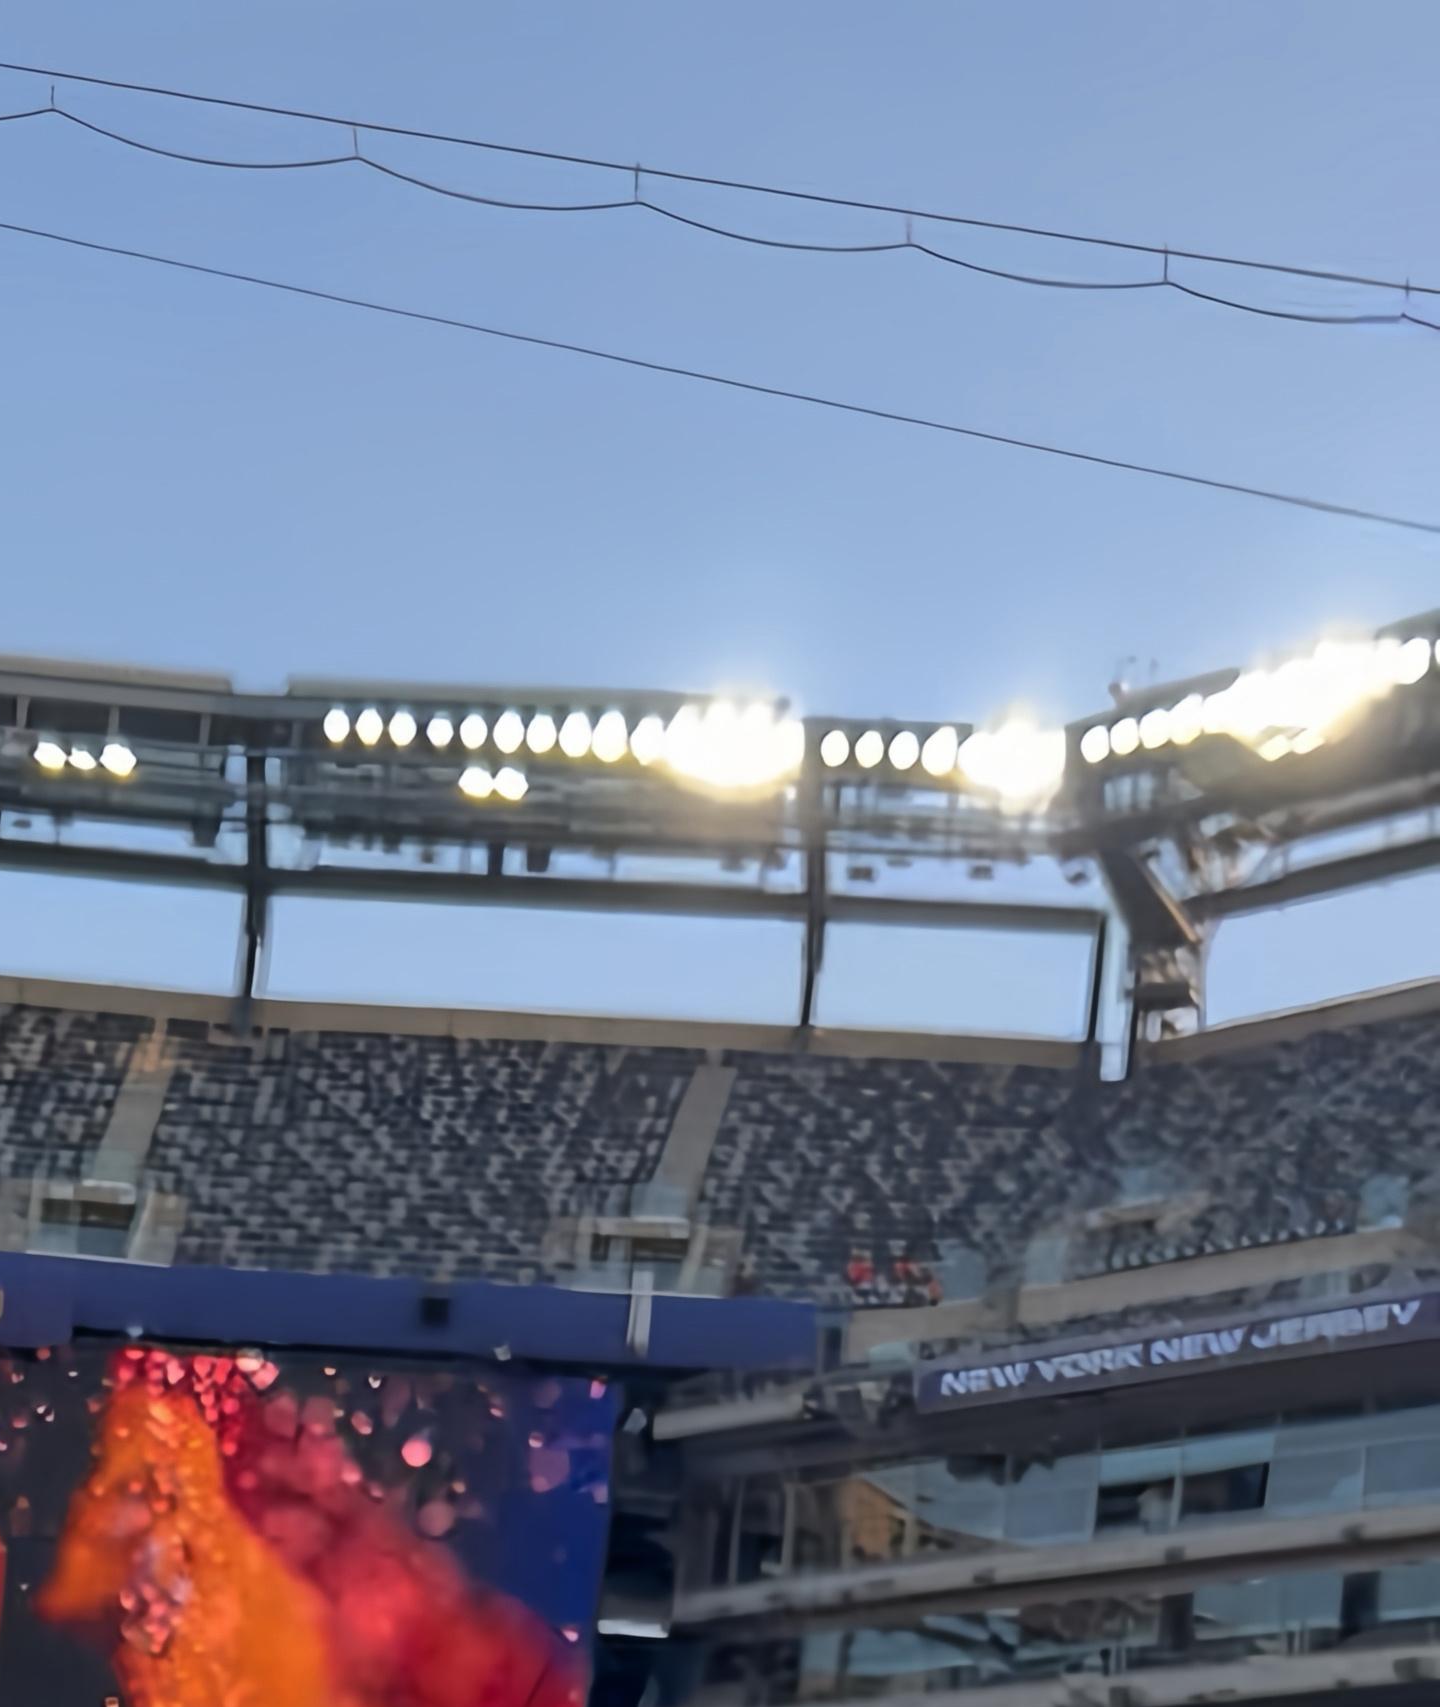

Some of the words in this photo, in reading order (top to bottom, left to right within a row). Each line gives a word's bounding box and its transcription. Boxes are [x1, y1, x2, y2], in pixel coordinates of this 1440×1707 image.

[940, 1361, 1030, 1397] NEW
[1034, 1343, 1145, 1383] YORK
[1151, 1328, 1246, 1366] NEW
[1249, 1299, 1422, 1350] JERSEY
